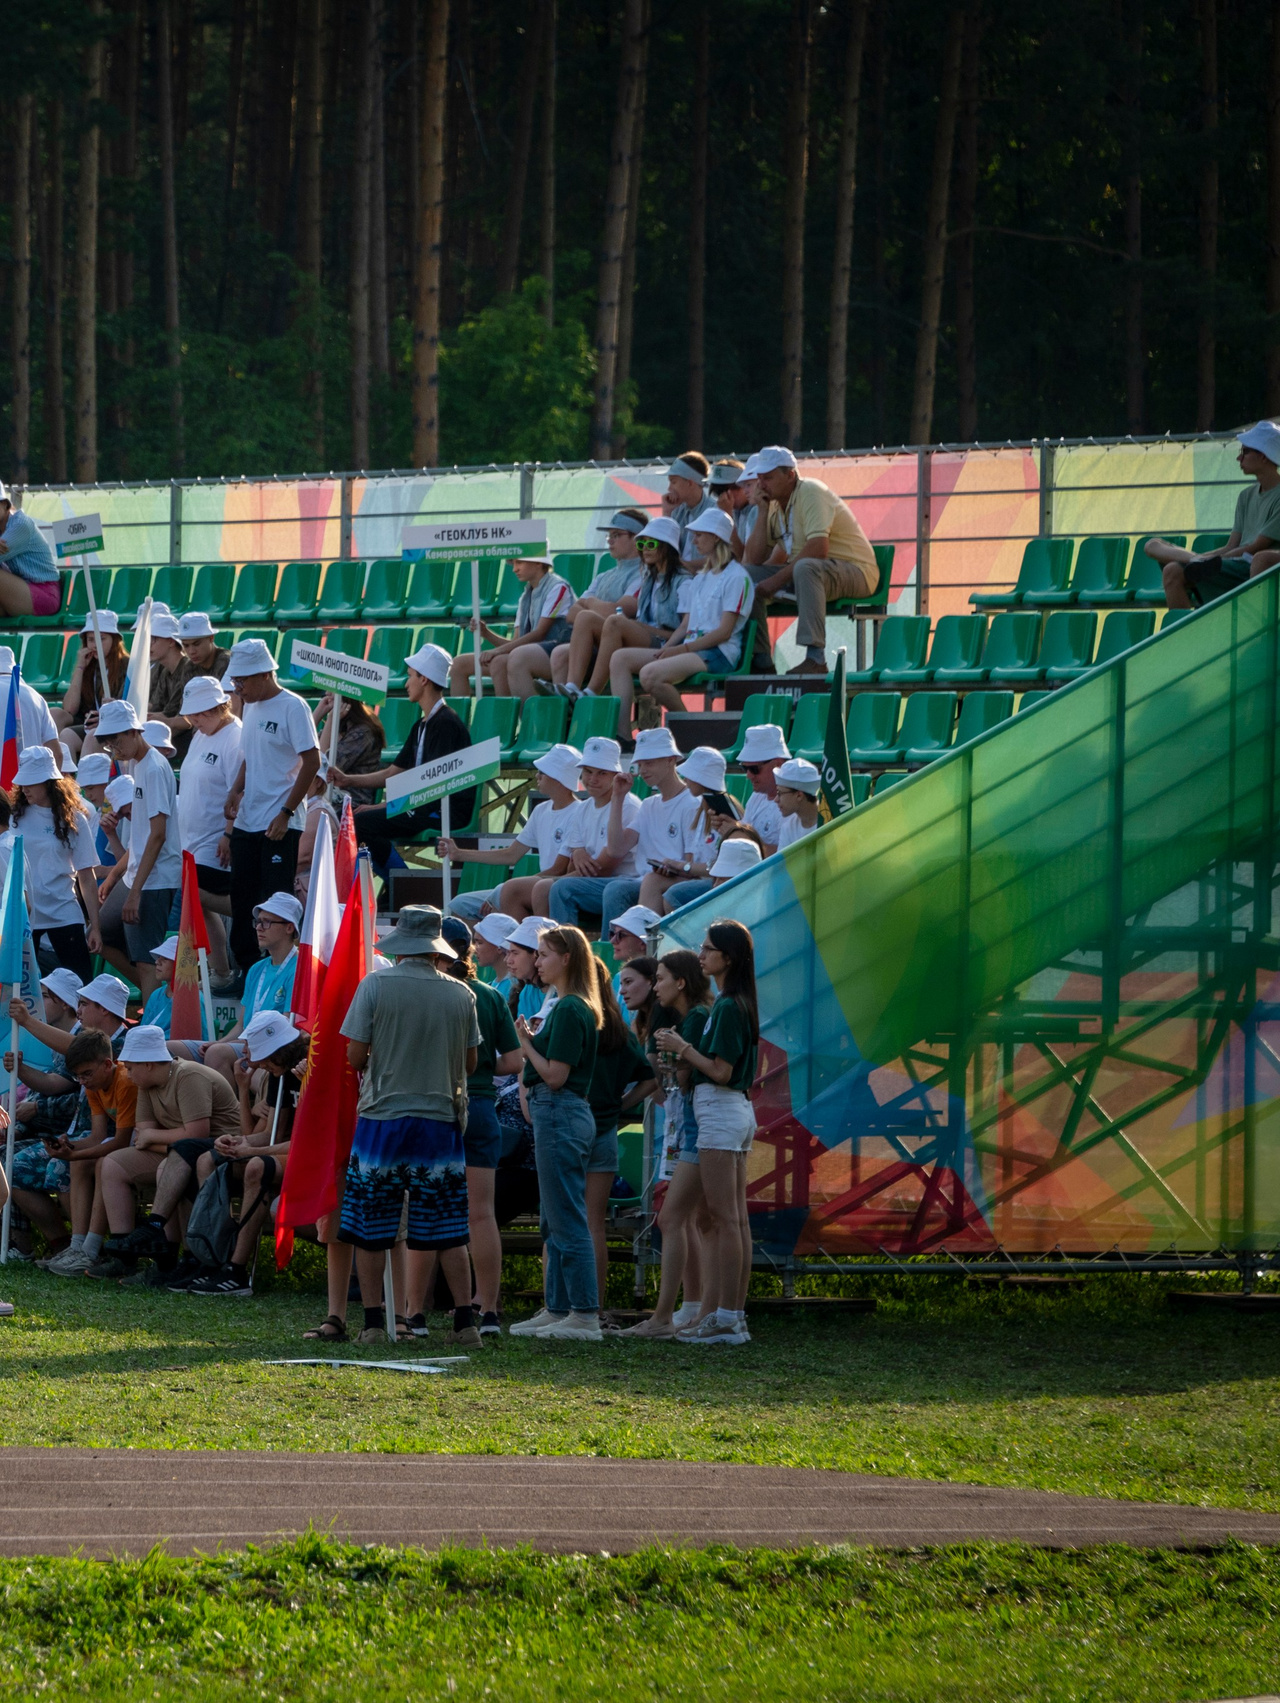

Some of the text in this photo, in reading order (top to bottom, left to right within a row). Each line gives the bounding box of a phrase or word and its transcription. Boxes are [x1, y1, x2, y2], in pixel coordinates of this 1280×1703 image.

[434, 527, 512, 541] «ГЕОКЛУБ НК»
[425, 546, 523, 560] Кемеровская область
[296, 649, 382, 682] «ШКОЛА ЮНОГО ГЕОЛОГА»
[312, 672, 362, 696] Томская область
[420, 758, 463, 780] «ЧАРОИТ»
[409, 774, 476, 806] Иркутская область
[215, 1006, 237, 1020] РЯД
